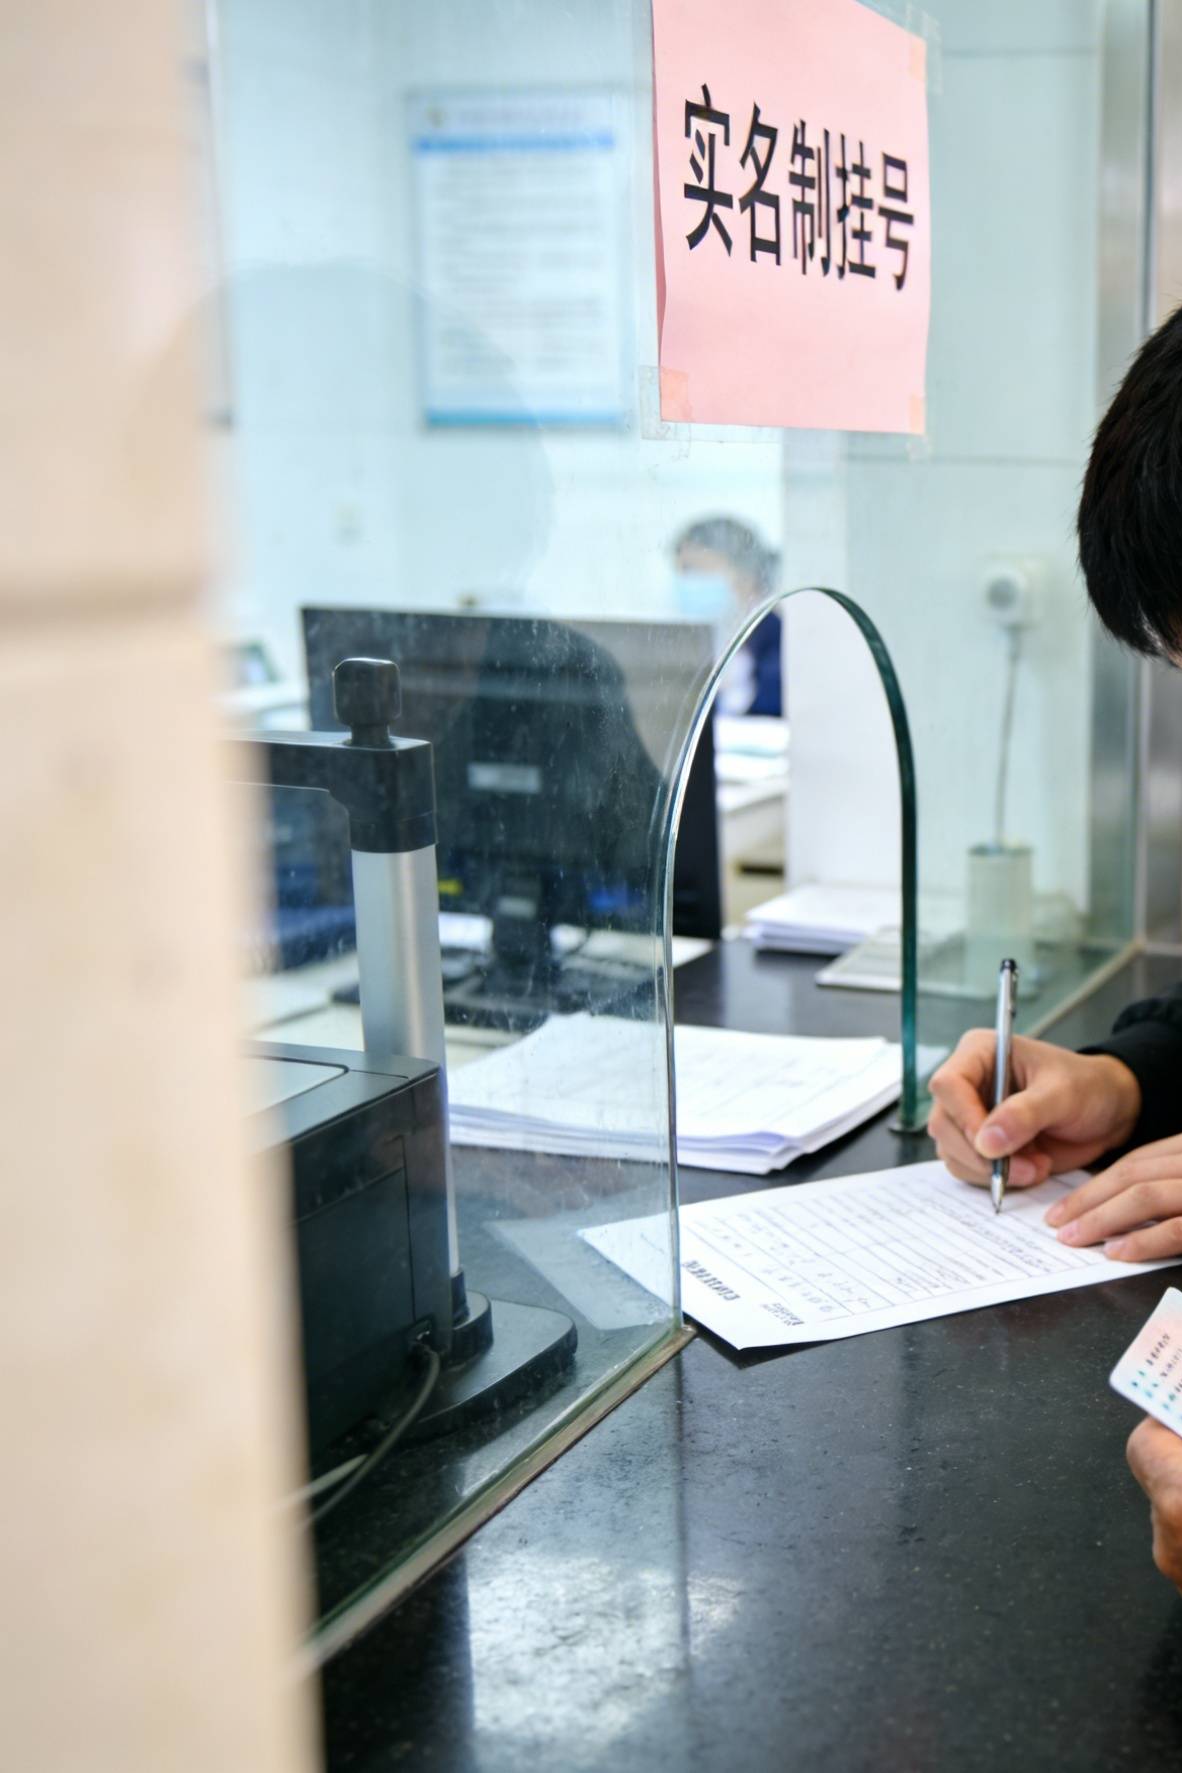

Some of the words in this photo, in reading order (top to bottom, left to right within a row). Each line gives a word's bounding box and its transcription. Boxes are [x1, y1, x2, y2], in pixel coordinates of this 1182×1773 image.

[683, 83, 915, 291] 实名制挂号
